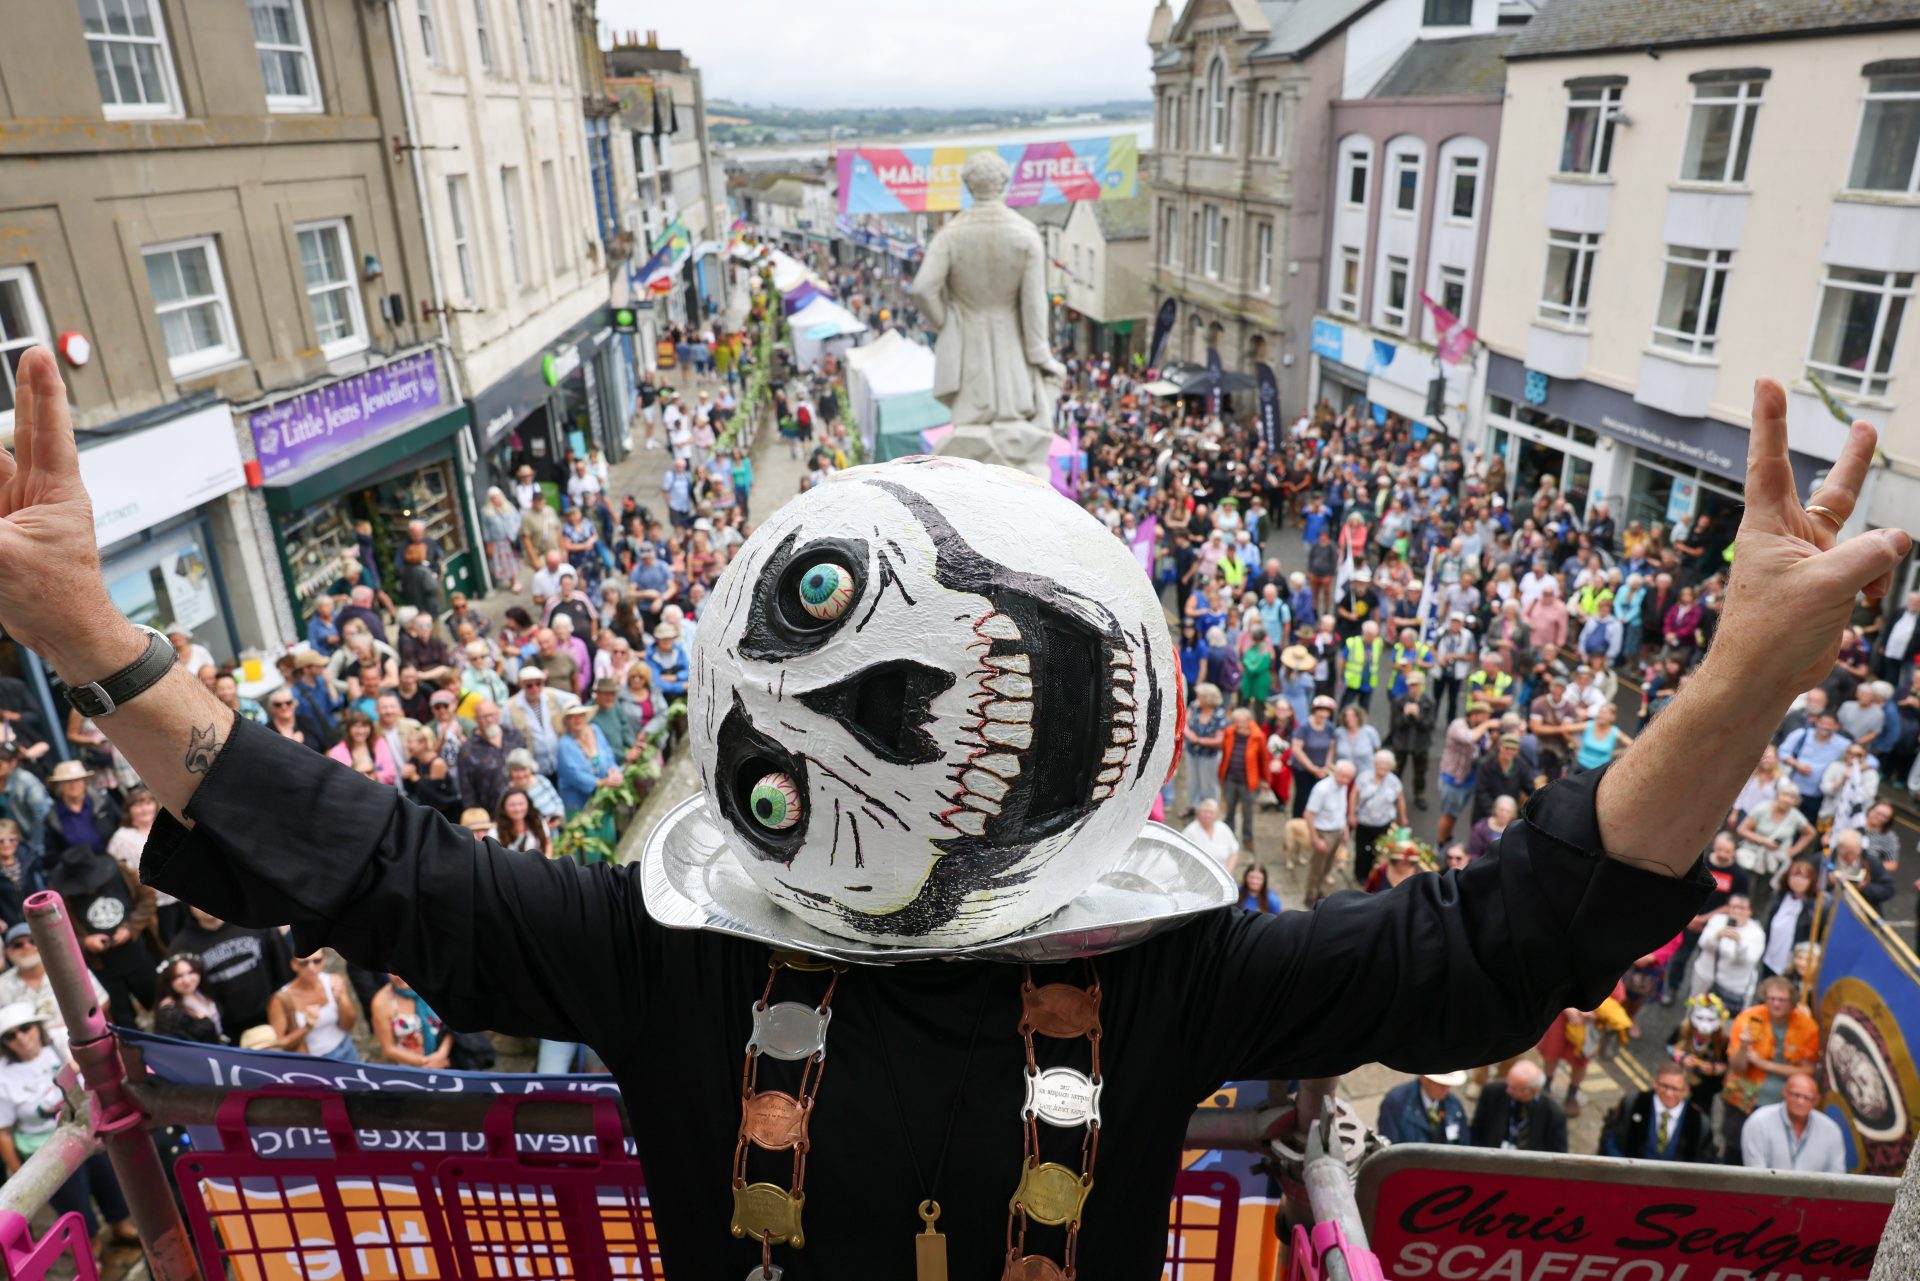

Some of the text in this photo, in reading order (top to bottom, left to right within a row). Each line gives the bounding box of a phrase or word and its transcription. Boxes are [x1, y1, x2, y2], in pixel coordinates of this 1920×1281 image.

[878, 164, 964, 185] MARKET
[1021, 155, 1098, 180] STREET
[280, 413, 325, 448] Little
[360, 379, 419, 421] Jewellery
[1399, 1185, 1593, 1244] Chris
